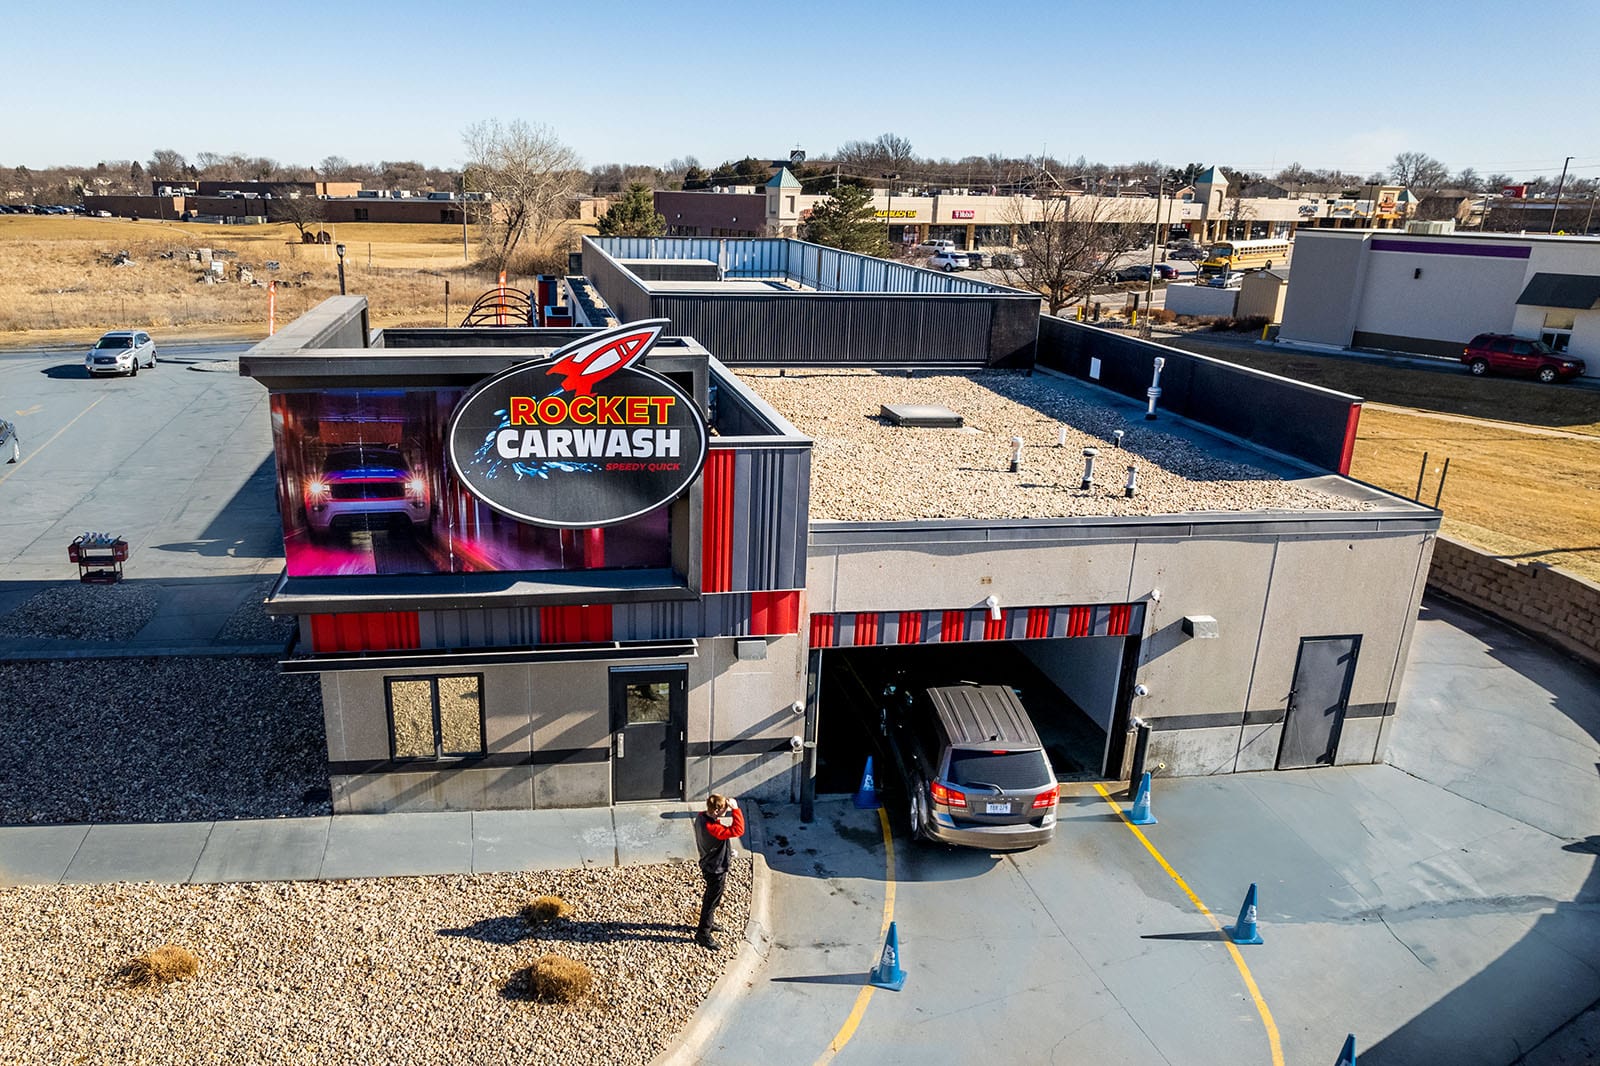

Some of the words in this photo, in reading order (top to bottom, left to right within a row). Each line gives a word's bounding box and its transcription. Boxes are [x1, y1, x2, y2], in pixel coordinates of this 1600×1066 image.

[510, 395, 676, 425] ROCKET
[496, 429, 680, 459] CARWASH
[605, 462, 647, 471] SPEEDY
[647, 462, 680, 473] QUICK
